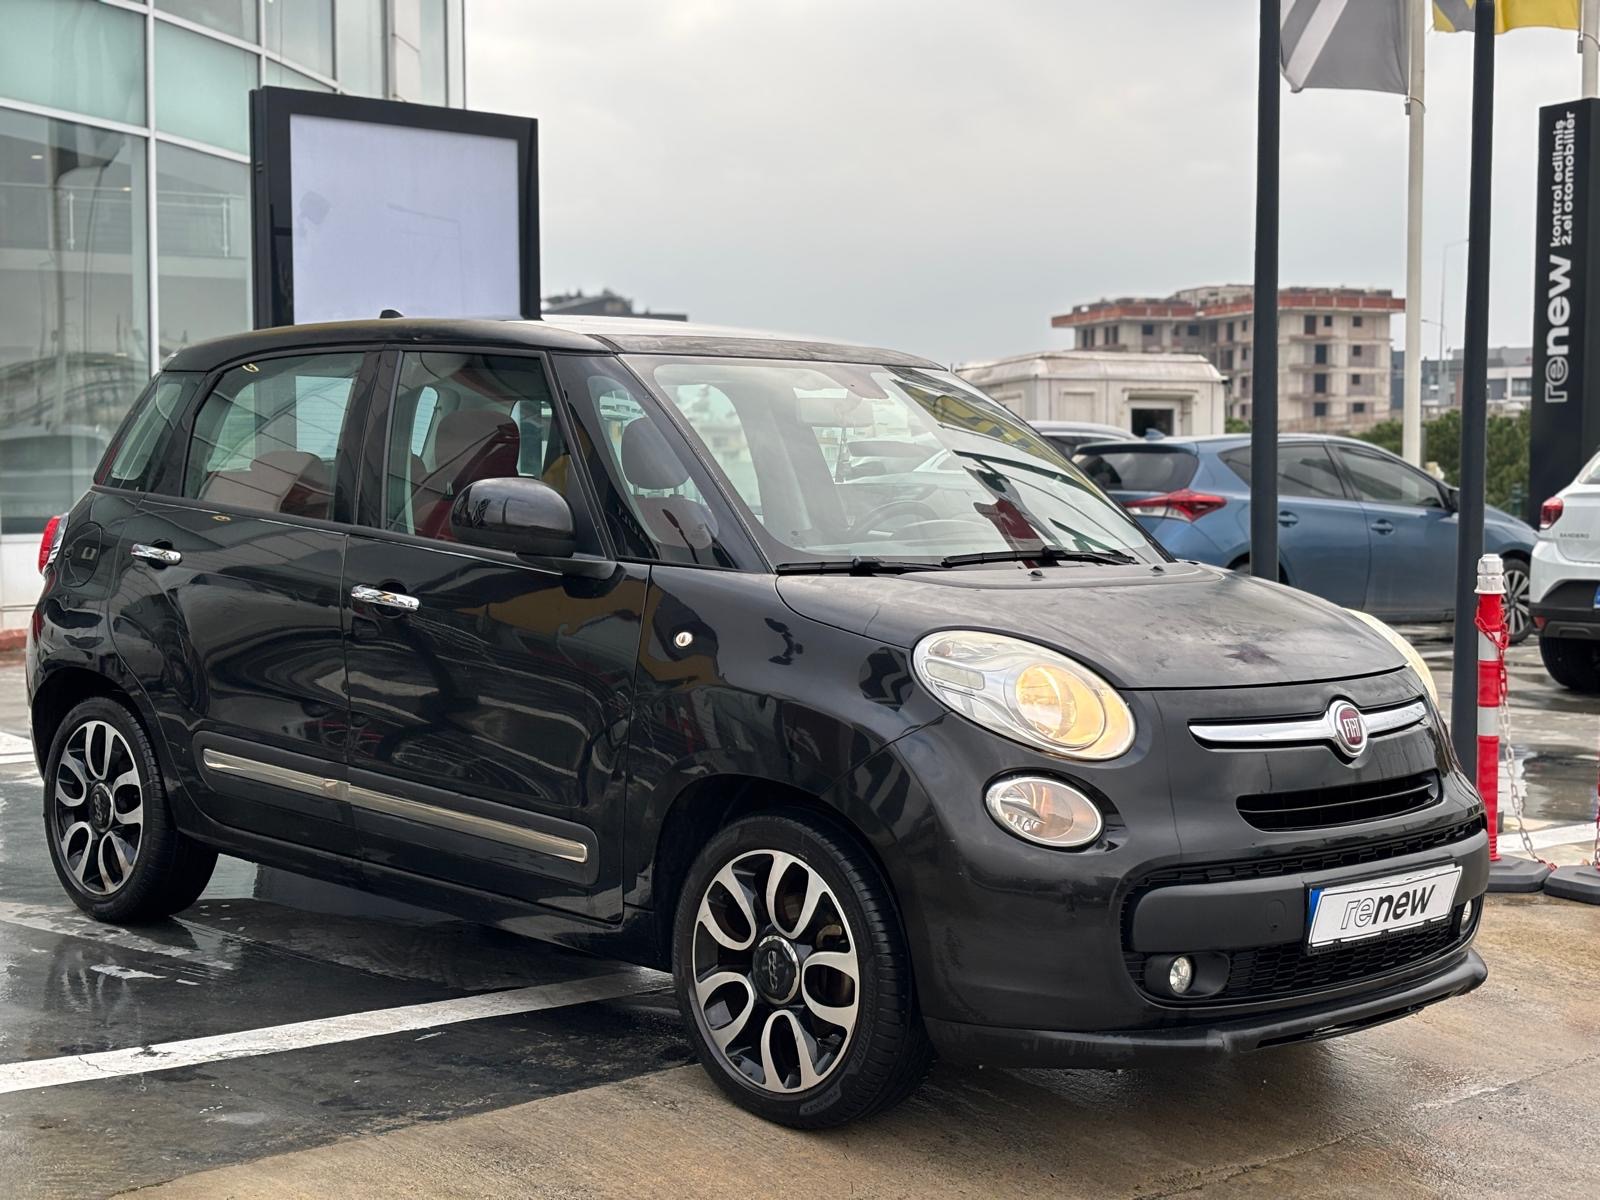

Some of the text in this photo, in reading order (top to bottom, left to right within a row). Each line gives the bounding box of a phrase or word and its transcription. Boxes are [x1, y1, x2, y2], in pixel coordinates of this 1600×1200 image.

[1550, 119, 1566, 247] kontrol edilmiş
[1561, 111, 1576, 246] 2.el otomobiller
[1545, 254, 1572, 403] renew
[1342, 717, 1362, 738] FIAT
[1340, 884, 1436, 930] renew
